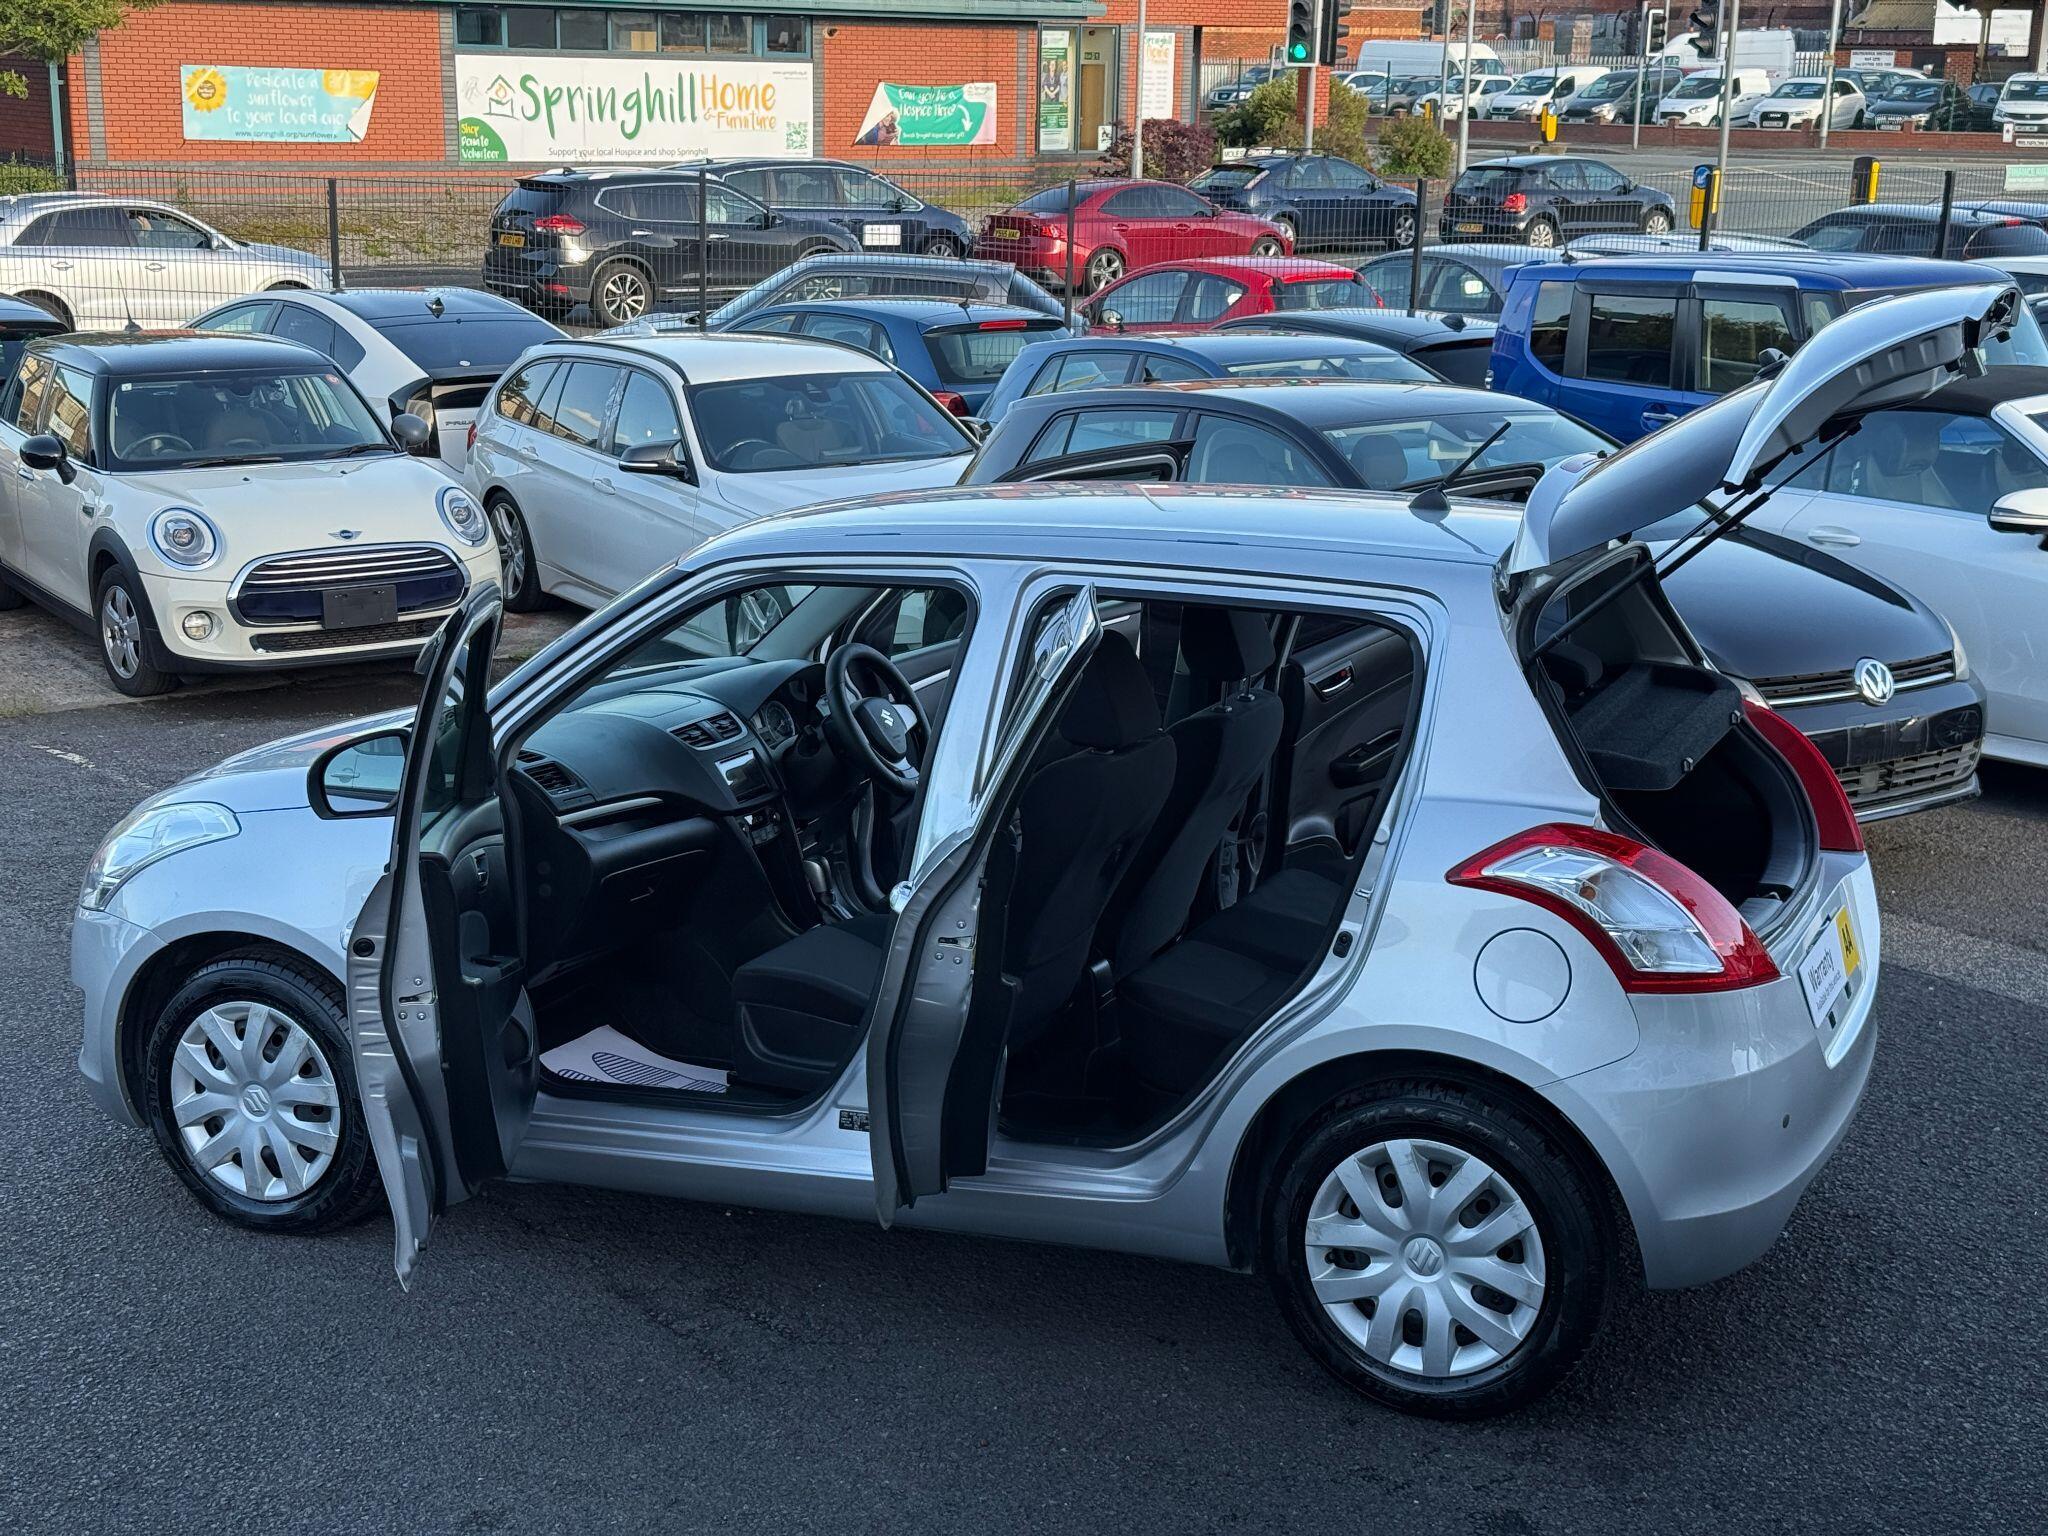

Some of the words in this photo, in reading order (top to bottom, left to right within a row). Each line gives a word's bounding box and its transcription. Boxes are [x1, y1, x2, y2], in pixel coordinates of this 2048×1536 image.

[245, 71, 304, 89] Dedicate
[309, 78, 319, 89] a
[247, 90, 315, 108] sunflower
[898, 88, 915, 100] Can
[519, 71, 698, 141] Springhill
[700, 73, 777, 112] Home
[899, 104, 932, 121] Hospice
[226, 107, 241, 124] to
[245, 111, 275, 128] your
[279, 108, 318, 126] loved
[321, 113, 344, 126] one
[703, 107, 716, 121] &
[717, 110, 777, 131] Furniture
[461, 123, 480, 137] Shop
[548, 147, 577, 158] Support
[578, 149, 595, 159] your
[596, 147, 614, 156] local
[615, 147, 642, 158] Hospice
[643, 147, 657, 156] and
[658, 147, 677, 158] shop
[677, 147, 709, 159] Springhill
[1808, 949, 1836, 993] Warranty
